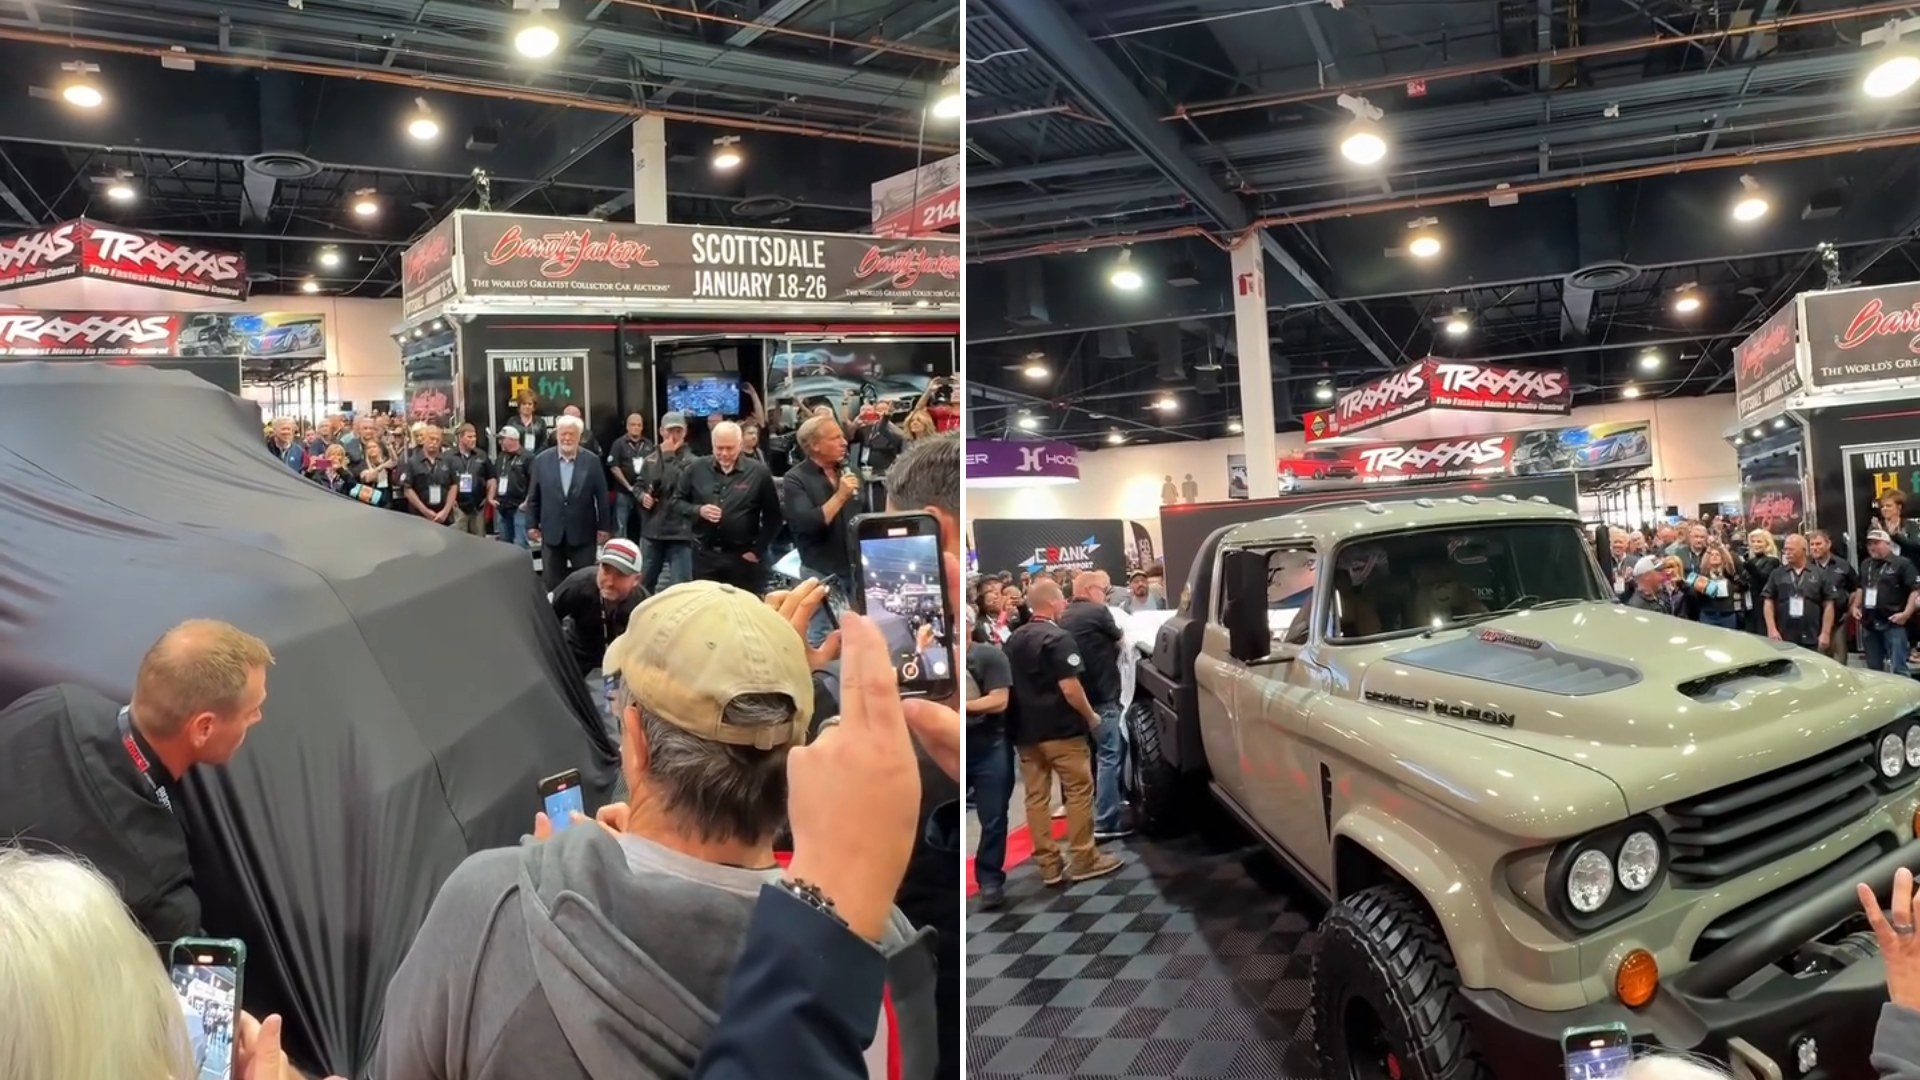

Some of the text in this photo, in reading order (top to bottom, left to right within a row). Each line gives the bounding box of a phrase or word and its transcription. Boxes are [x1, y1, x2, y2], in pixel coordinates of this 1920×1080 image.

[0, 224, 75, 271] XXAS
[90, 229, 239, 281] TRAXXAS
[692, 232, 826, 268] SCOTTSDALE
[46, 264, 76, 278] Control
[89, 264, 109, 276] The
[110, 268, 148, 282] Fastest
[149, 275, 175, 287] Name
[186, 281, 210, 292] Radio
[211, 285, 239, 296] Control
[472, 279, 489, 289] THE
[491, 279, 528, 289] WORLD'S
[529, 279, 569, 289] GREATEST
[570, 280, 614, 290] COLLECTOR
[615, 282, 630, 291] CAR
[692, 270, 827, 299] JANUARY 18-26
[845, 289, 857, 297] THE
[503, 357, 574, 372] WATCH LIVE ON
[1820, 366, 1843, 376] THE
[1845, 360, 1893, 374] WORLD'S
[1435, 364, 1562, 398] TRAXXAS
[1340, 363, 1424, 419] TRAXXAS
[1436, 397, 1452, 405] The
[1453, 398, 1483, 407] Fastest
[1484, 400, 1506, 408] Name
[1538, 403, 1564, 411] Control
[1360, 436, 1506, 472] TRAXXAS
[1863, 450, 1905, 469] WATCH
[1411, 472, 1435, 480] Name
[1446, 469, 1471, 477] Radio
[1473, 467, 1506, 475] Control
[1035, 545, 1090, 564] CRANK
